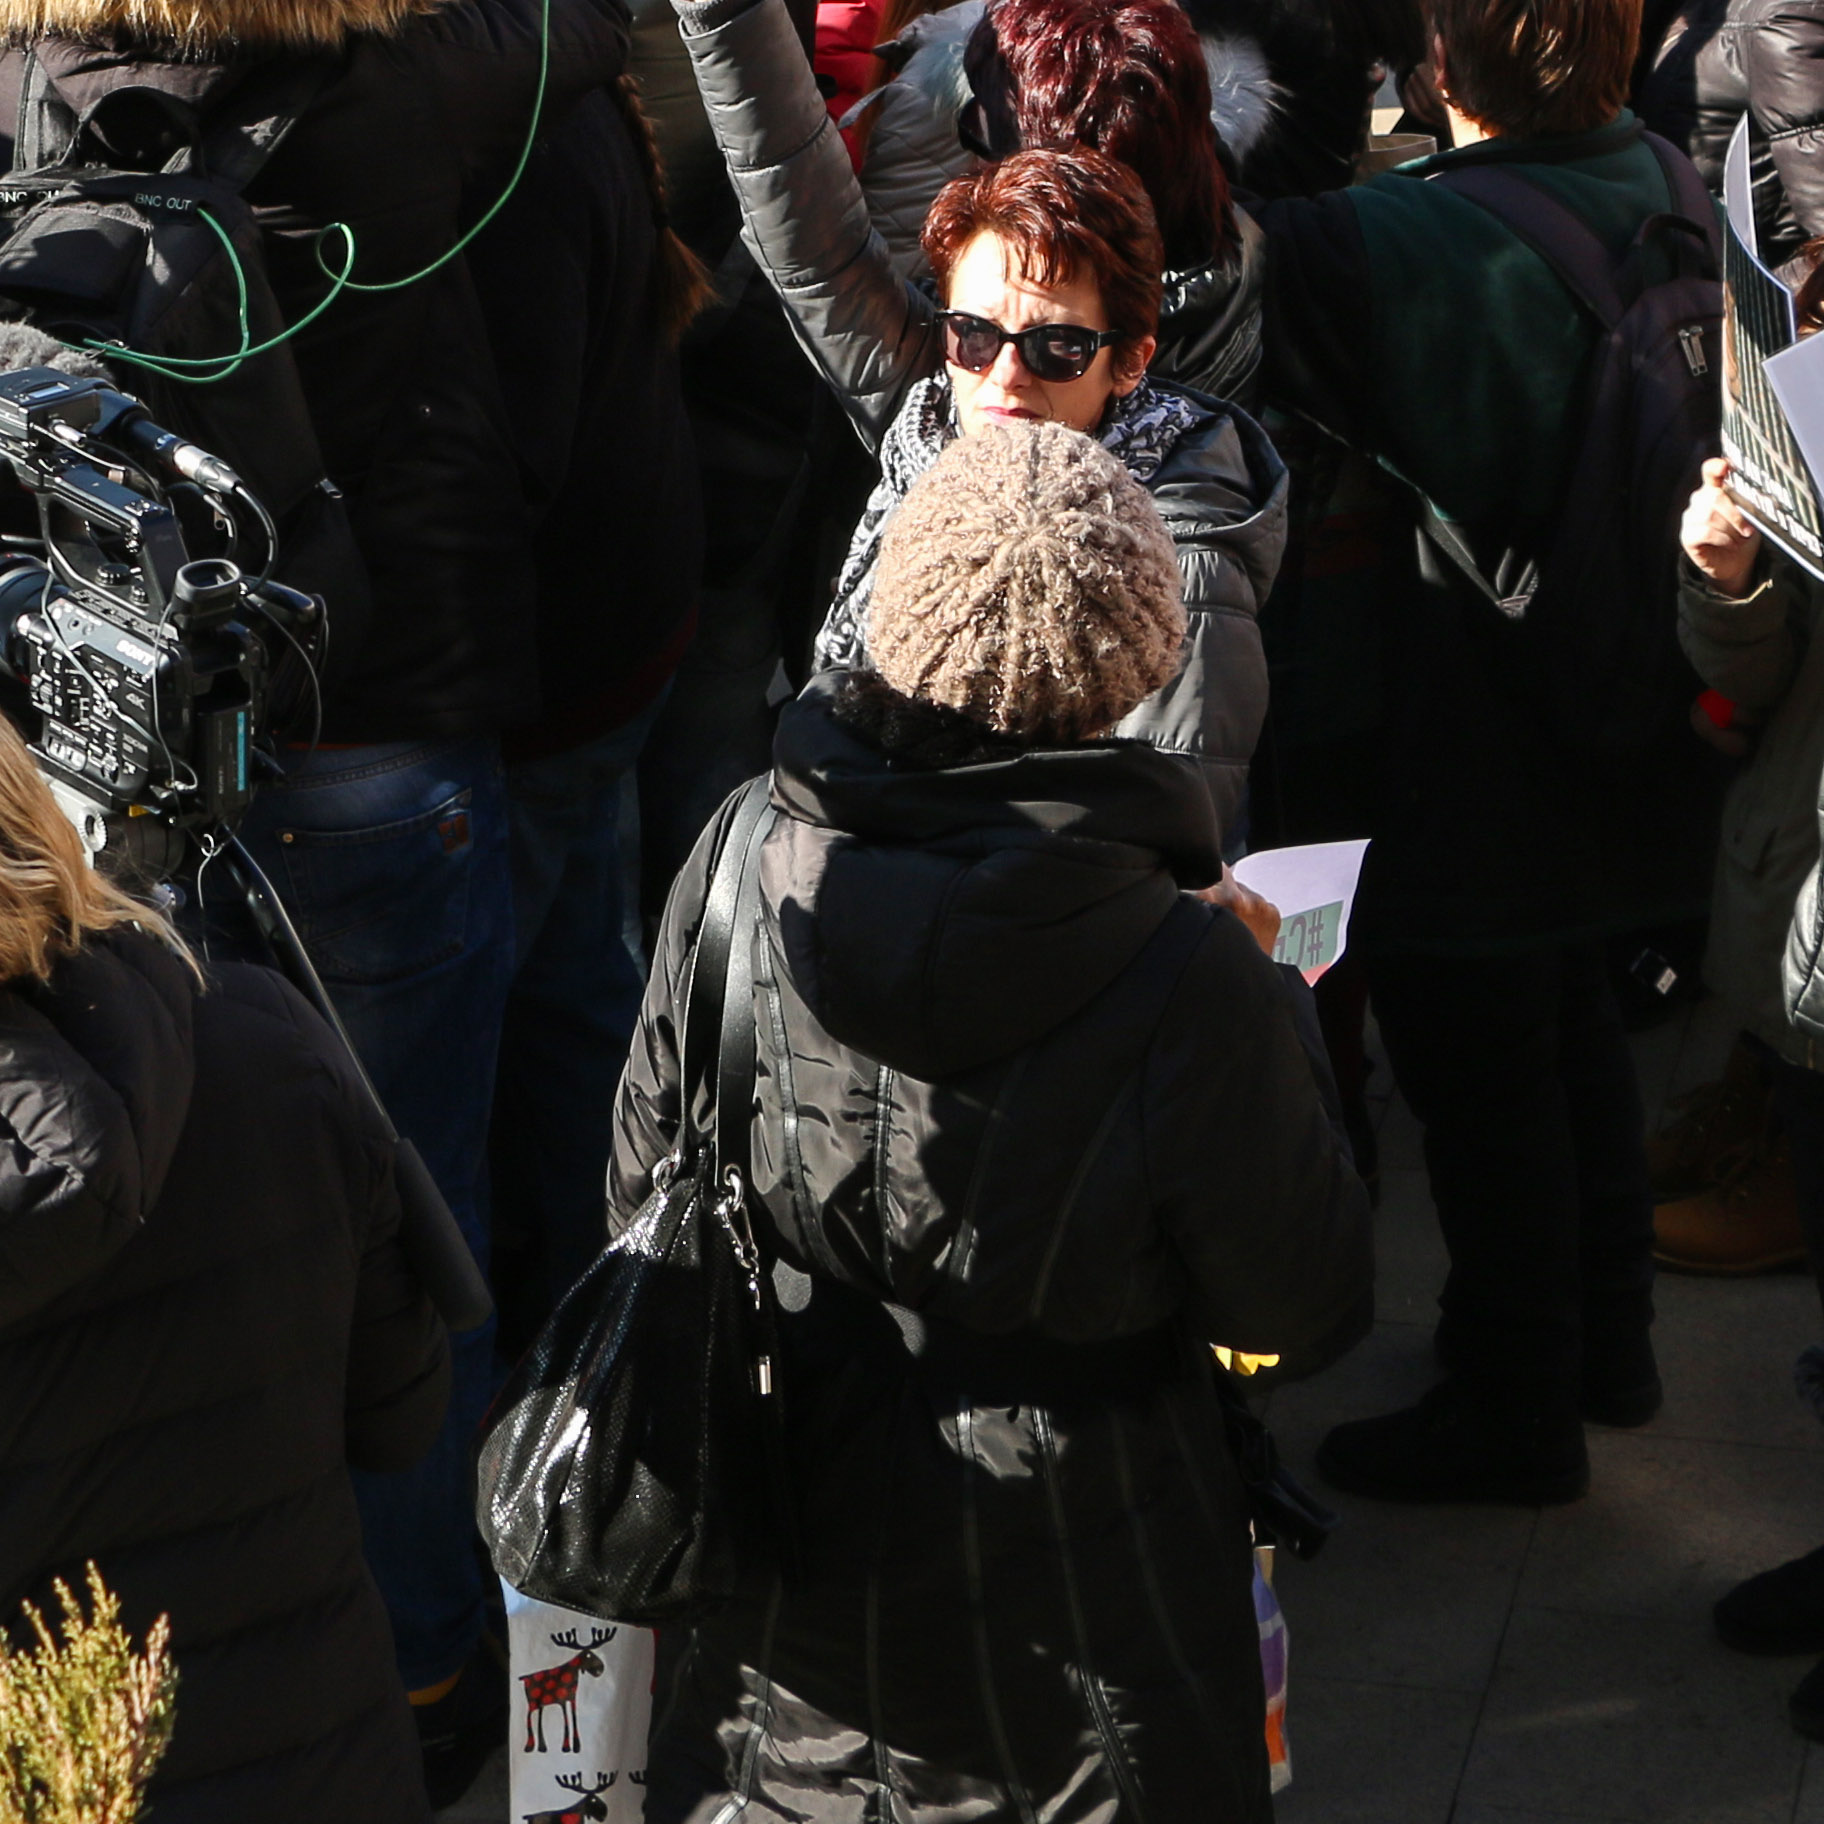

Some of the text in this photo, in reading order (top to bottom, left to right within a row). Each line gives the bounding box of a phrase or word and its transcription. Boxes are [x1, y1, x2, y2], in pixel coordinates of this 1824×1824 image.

[134, 192, 193, 210] BNC OUT
[116, 639, 155, 666] SONY
